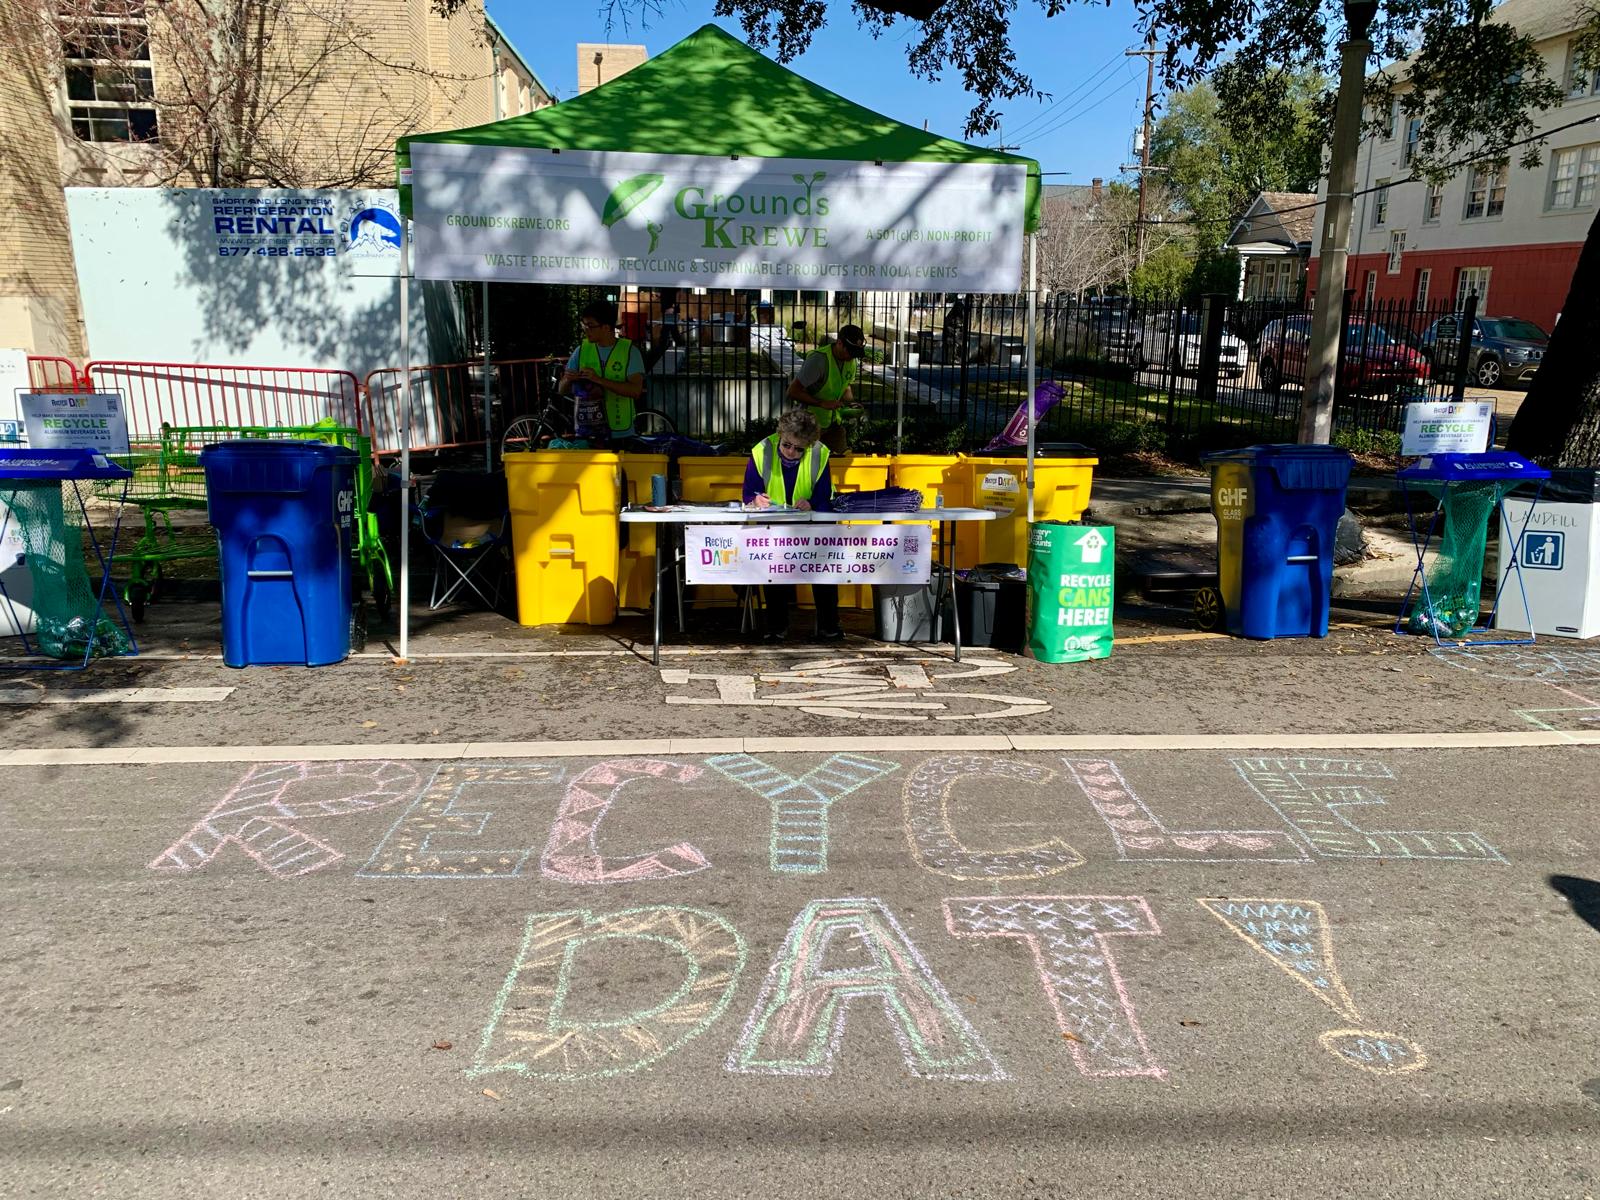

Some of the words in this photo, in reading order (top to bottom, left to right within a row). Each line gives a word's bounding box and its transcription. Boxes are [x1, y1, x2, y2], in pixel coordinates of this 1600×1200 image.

[674, 172, 830, 220] Grounds
[213, 206, 333, 216] REFRIGERATION
[214, 216, 334, 234] RENTAL
[446, 214, 570, 231] GROUNDSKREWE.ORG
[701, 216, 830, 249] KREWE
[865, 229, 874, 241] A
[876, 229, 924, 243] 501(c)(3)
[927, 230, 992, 242] NON-PROFIT
[484, 254, 527, 268] WASTE
[531, 255, 614, 272] PREVENTION,
[618, 259, 685, 273] RECYCLING
[689, 260, 698, 272] &
[702, 261, 782, 275] SUSTAINABLE
[786, 263, 849, 277] PRODUCTS
[852, 264, 876, 278] FOR
[880, 265, 911, 278] NOLA
[915, 266, 958, 279] EVENTS
[44, 419, 108, 429] RECYCLE
[1421, 424, 1475, 433] RECYCLE
[1218, 487, 1248, 506] GHF
[1509, 510, 1578, 528] LANDFILL
[746, 538, 770, 548] FREE
[773, 537, 811, 547] THROW
[814, 536, 867, 547] DONATION
[871, 537, 899, 547] BAGS
[748, 552, 774, 561] TAKE
[783, 551, 818, 560] CATCH
[827, 551, 845, 560] FILL
[855, 552, 895, 560] RETURN
[769, 564, 796, 574] HELP
[799, 563, 843, 573] CREATE
[846, 563, 876, 574] JOBS
[1060, 573, 1111, 588] RECYCLE
[1058, 587, 1111, 608] CANS
[1057, 607, 1110, 627] HERE!
[147, 752, 1511, 884] RECYCLE
[463, 895, 1430, 1082] DAT!
